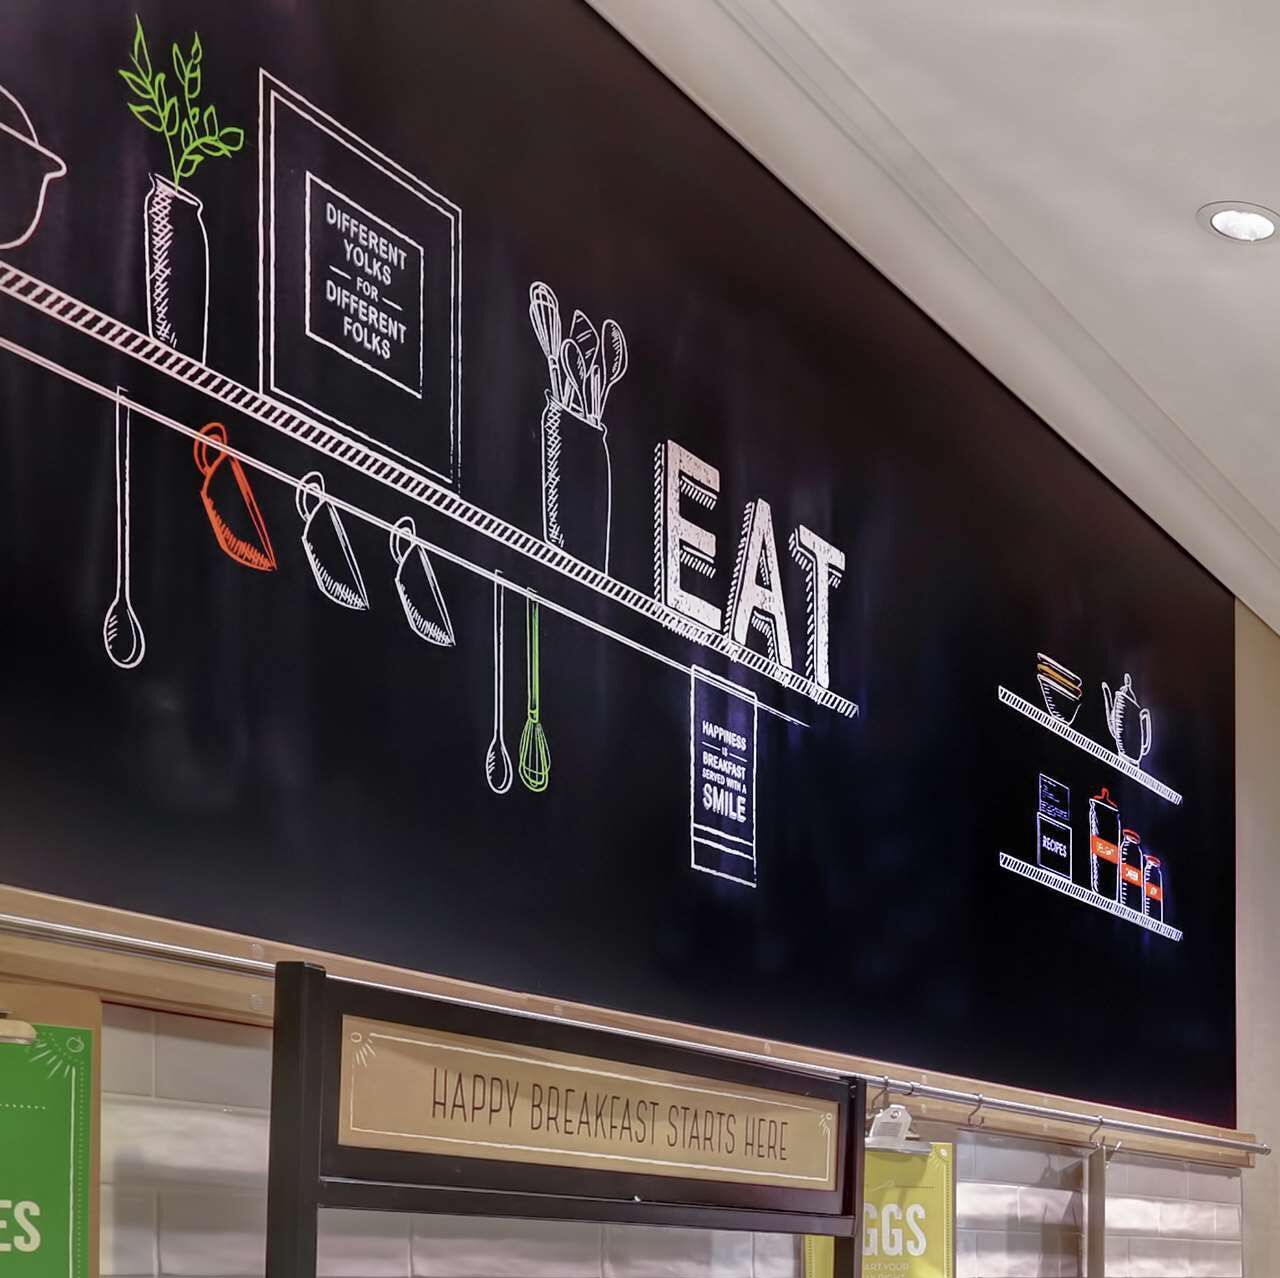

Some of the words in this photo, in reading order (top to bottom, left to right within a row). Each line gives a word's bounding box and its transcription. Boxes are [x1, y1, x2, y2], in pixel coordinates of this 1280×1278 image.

[326, 202, 407, 270] DIFFERENT
[344, 239, 391, 286] YOLKS
[356, 277, 379, 302] FOR
[326, 280, 407, 344] DIFFERENT
[343, 316, 391, 360] FOLKS
[655, 439, 846, 689] EAT
[702, 720, 747, 752] HAPPINESS
[702, 751, 746, 780] BREAKFAST
[702, 767, 725, 786] SERVED
[725, 777, 741, 792] WITH
[741, 784, 747, 794] A
[702, 783, 747, 823] SMILE
[1042, 835, 1067, 858] RECIPES
[432, 1067, 519, 1128] HAPPY
[530, 1083, 659, 1145] BREAKFAST
[666, 1104, 737, 1154] STARTS
[744, 1114, 789, 1161] HERE
[863, 1203, 927, 1256] GGS
